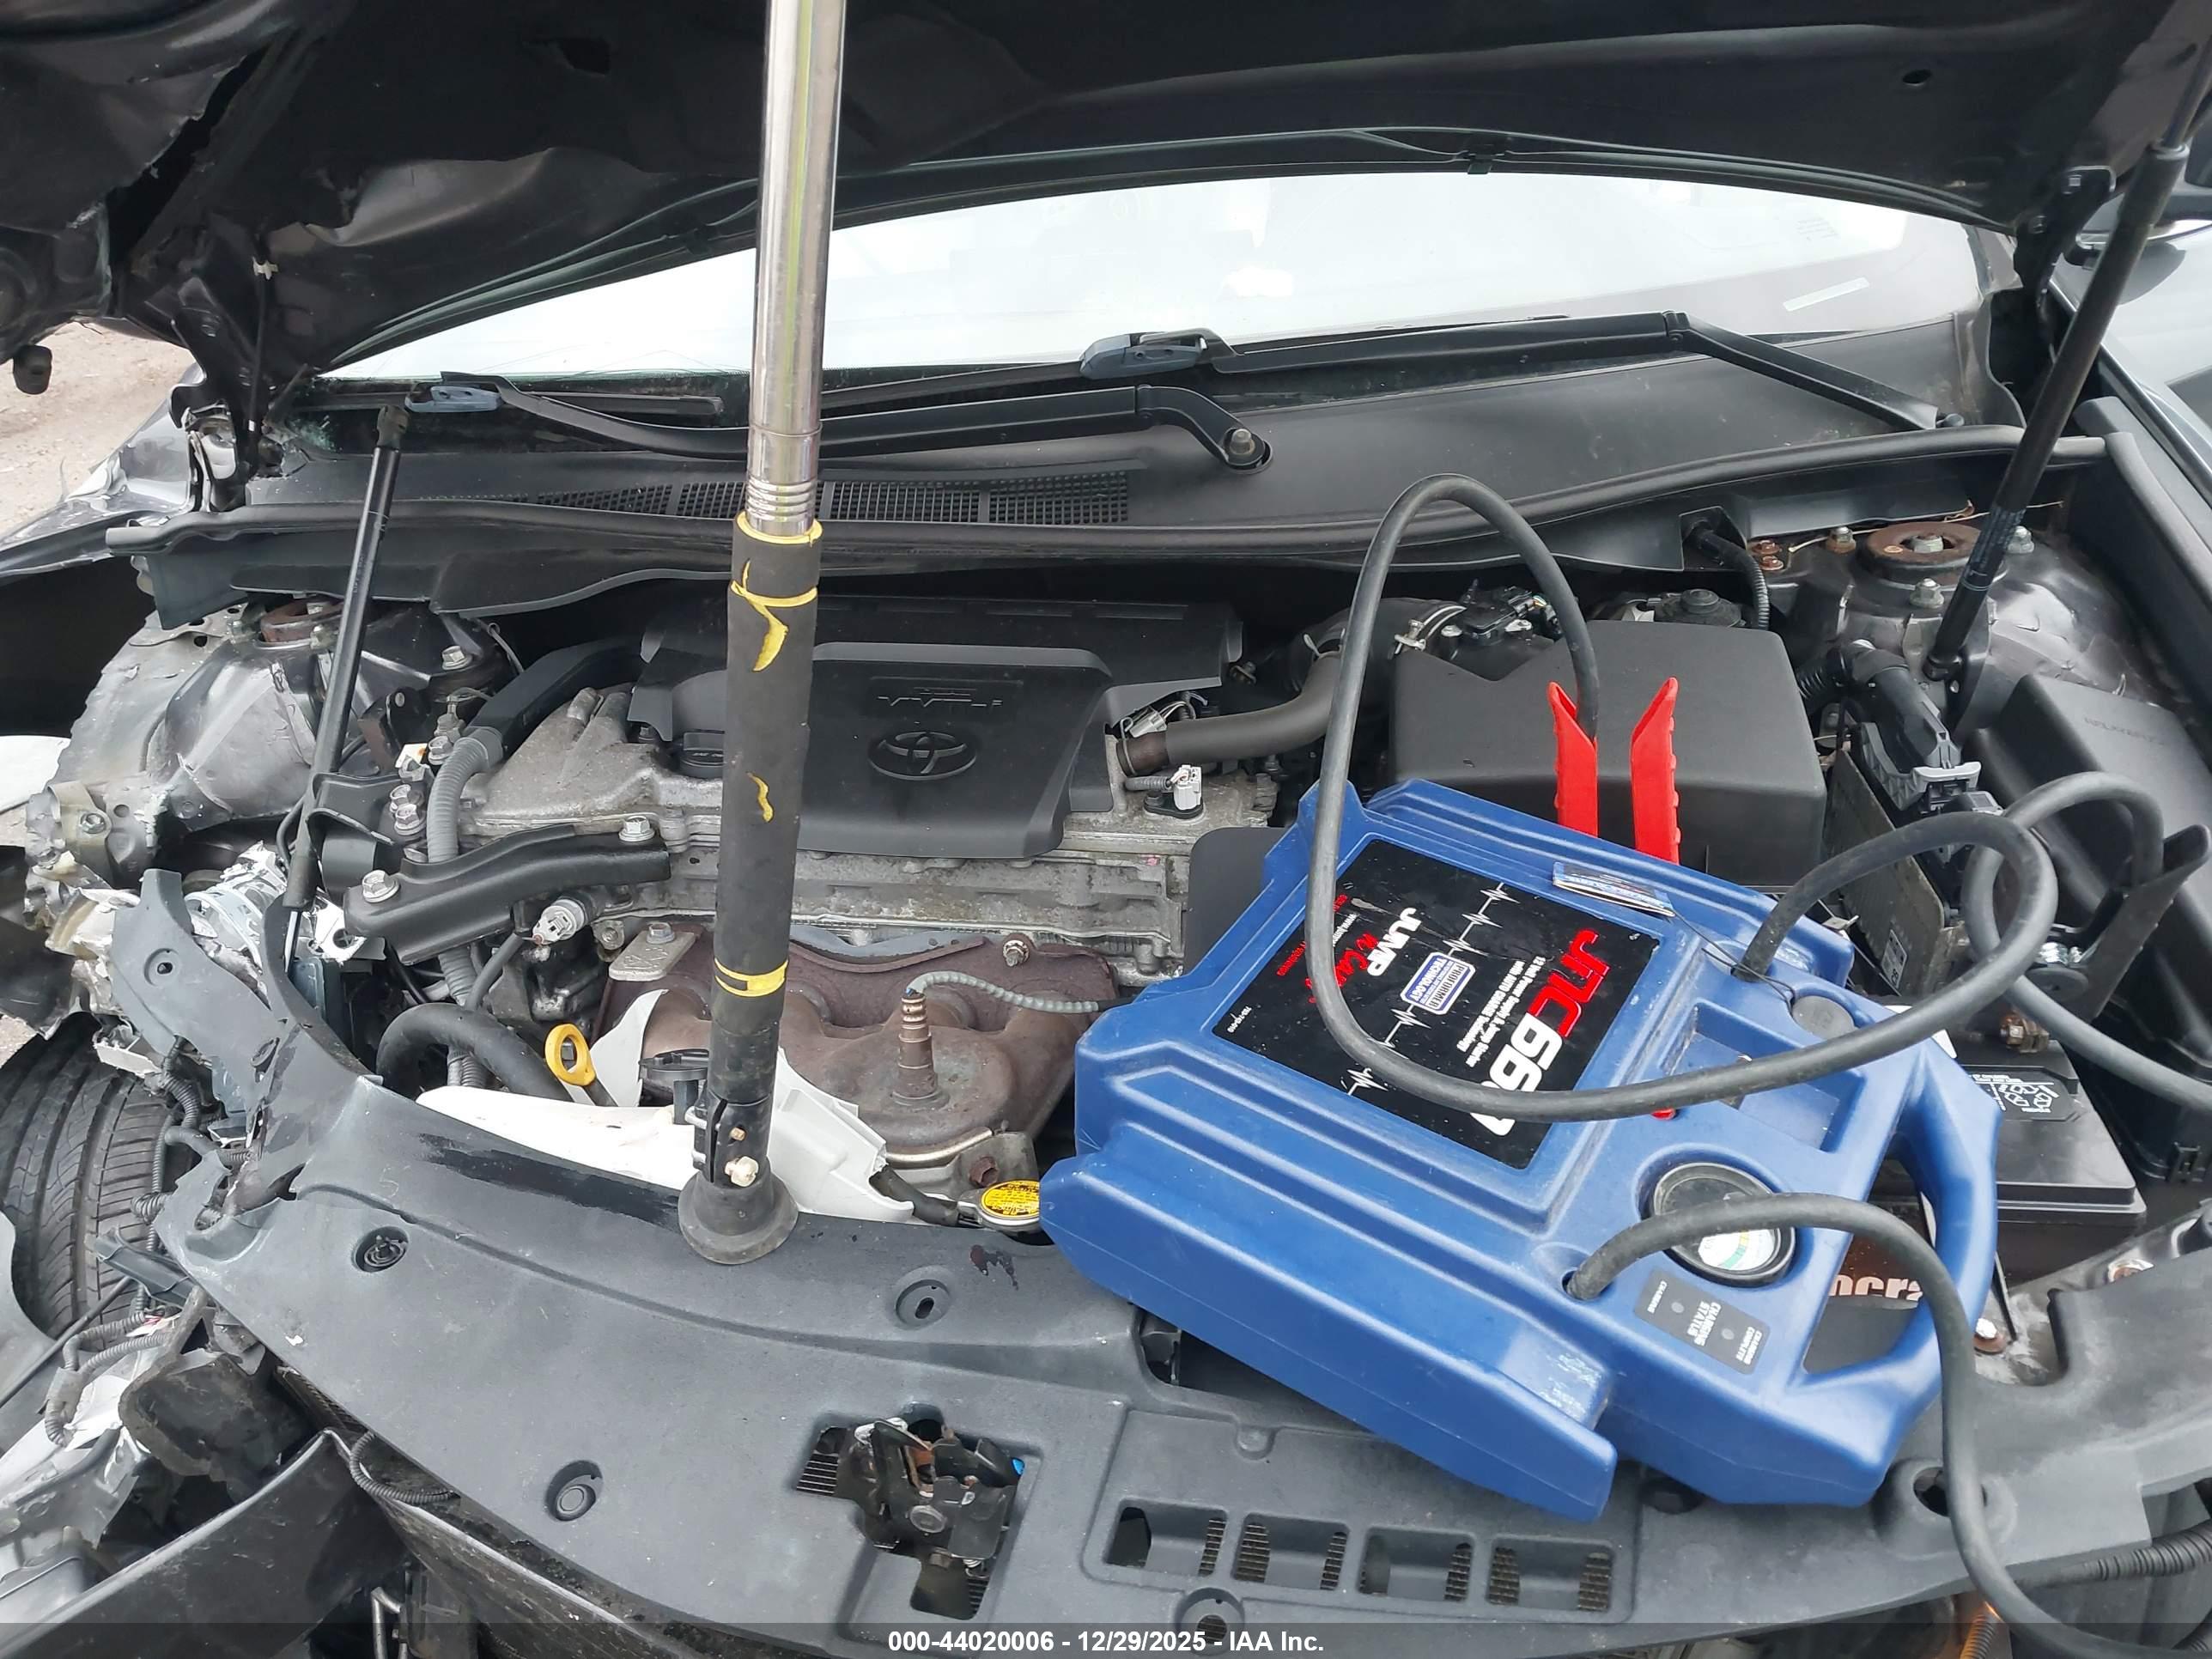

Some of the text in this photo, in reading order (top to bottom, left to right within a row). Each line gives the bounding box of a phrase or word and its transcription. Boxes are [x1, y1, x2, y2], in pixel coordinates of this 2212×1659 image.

[1367, 908, 1424, 976] JUMP
[1408, 957, 1446, 1001] TECHNOLOGY
[1427, 963, 1465, 1009] PROFORMER
[1498, 973, 1517, 993] AUTO
[1511, 975, 1534, 998] Power
[1465, 1042, 1489, 1067] Starter
[1686, 1299, 1710, 1337] STATUS
[1692, 1300, 1723, 1347] CHARGING
